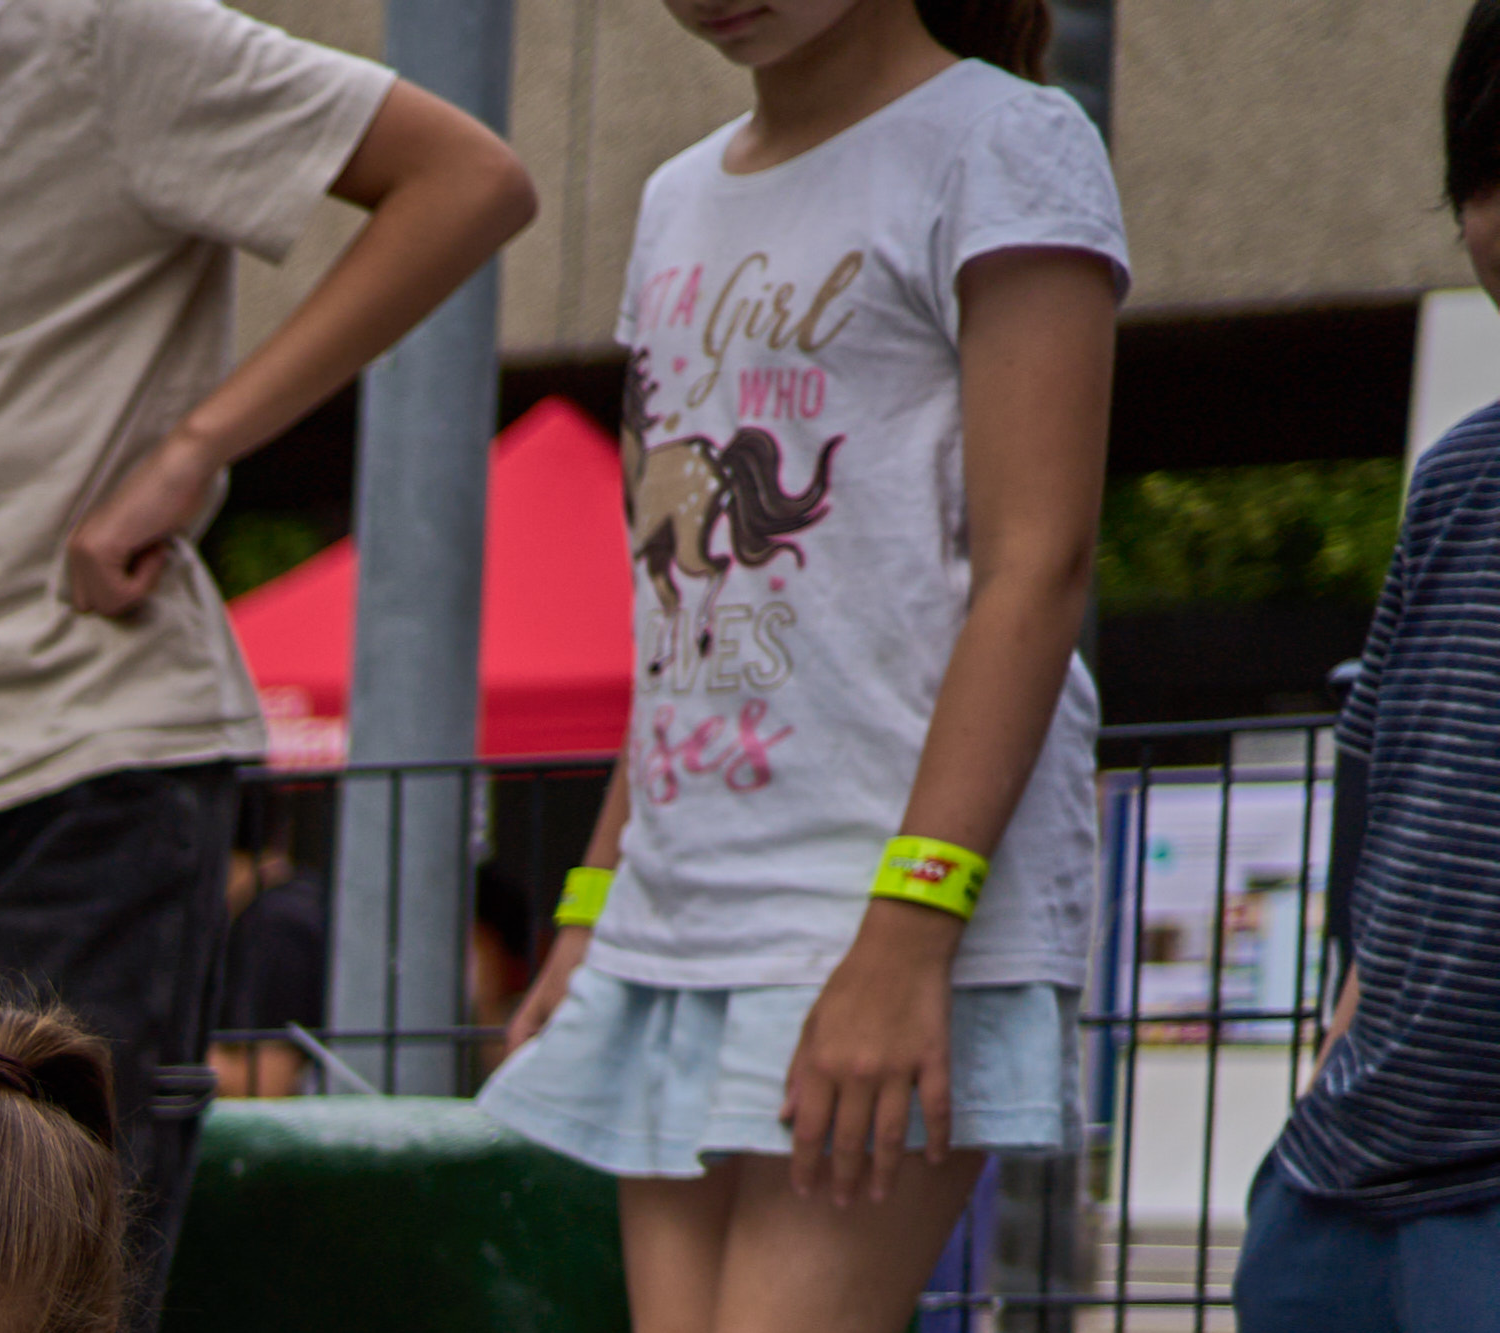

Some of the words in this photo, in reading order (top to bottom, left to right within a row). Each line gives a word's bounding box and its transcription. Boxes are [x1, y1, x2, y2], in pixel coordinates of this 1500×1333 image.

[667, 261, 705, 328] A
[686, 251, 865, 409] Girl
[737, 366, 826, 420] WHO
